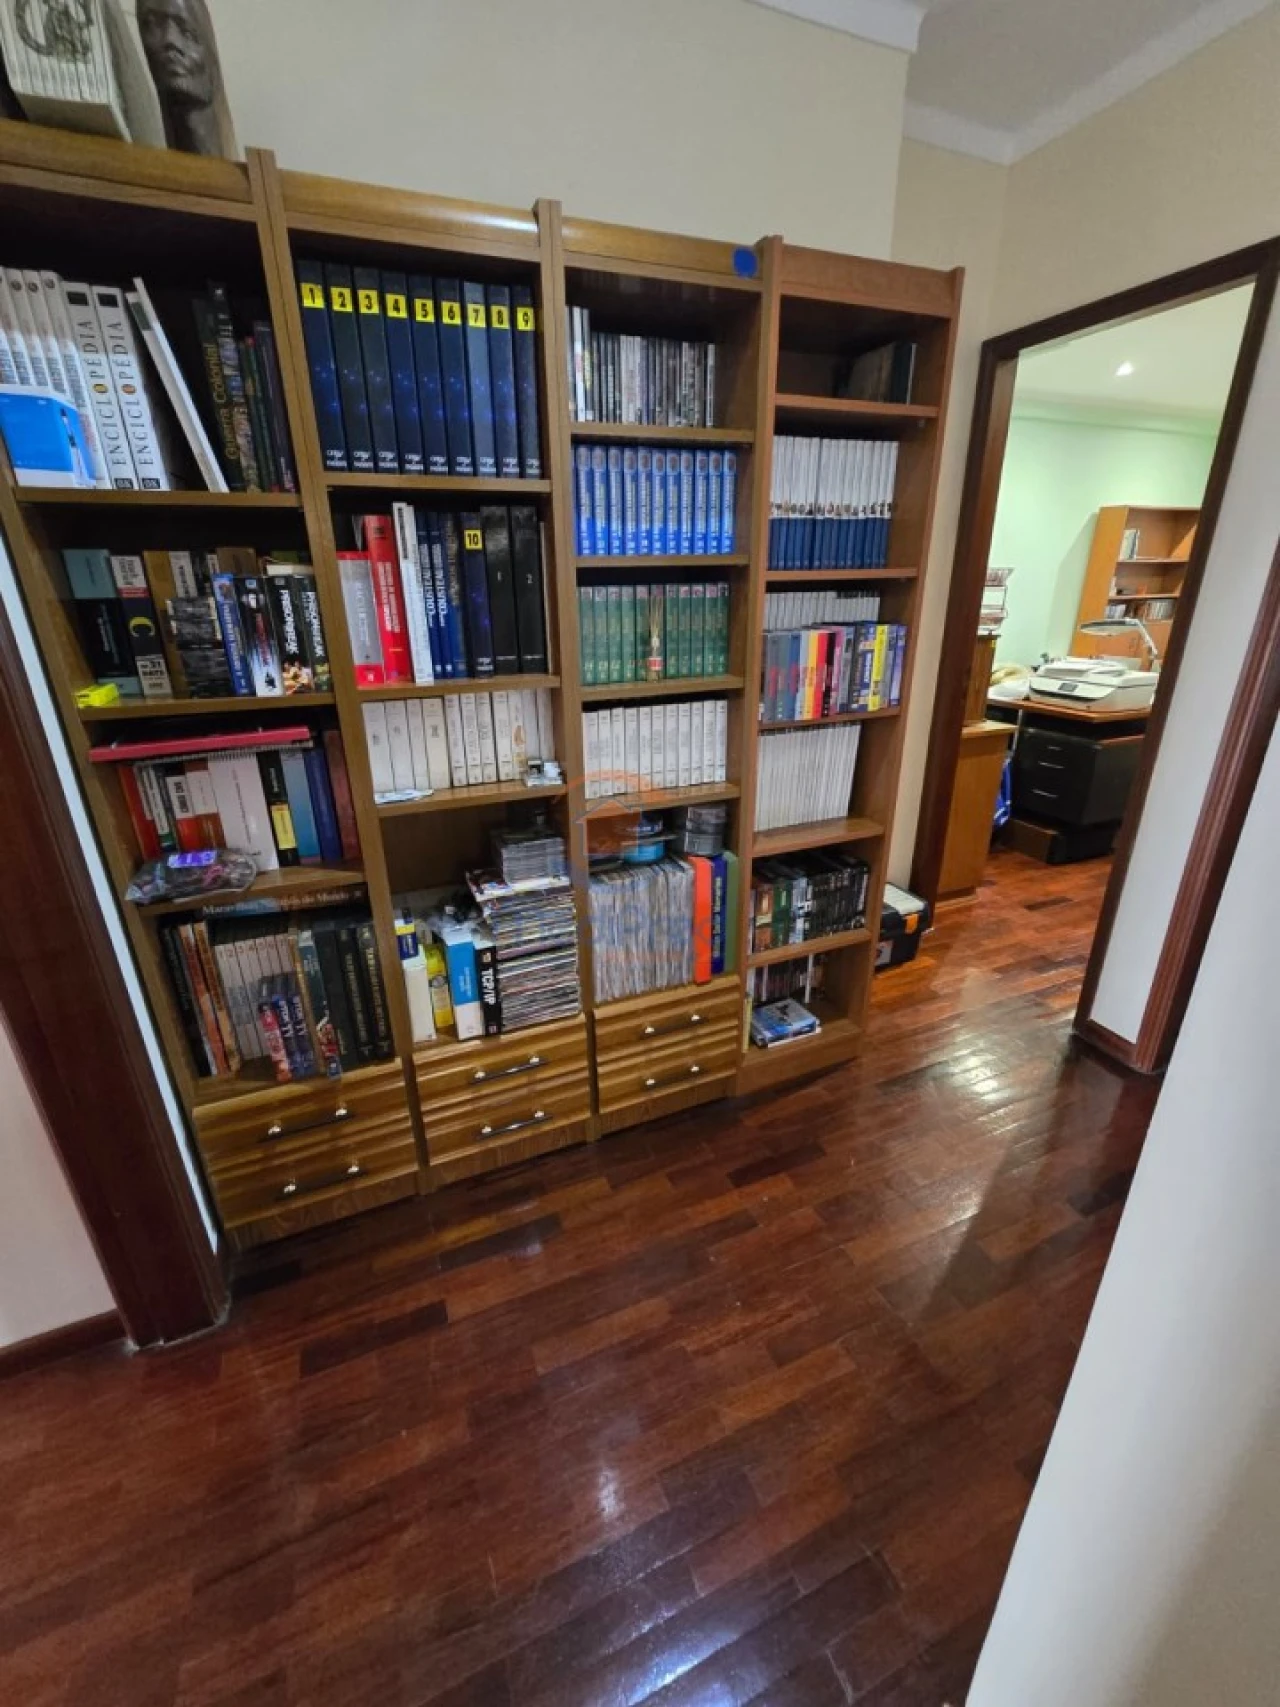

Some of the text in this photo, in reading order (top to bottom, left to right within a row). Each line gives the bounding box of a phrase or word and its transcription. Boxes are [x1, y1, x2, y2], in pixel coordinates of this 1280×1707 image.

[308, 287, 316, 304] 1
[338, 293, 347, 308] 2
[365, 295, 373, 309] 3
[392, 299, 400, 314] 4
[421, 303, 429, 318] 5
[447, 305, 455, 320] 6
[473, 308, 480, 322] 7
[497, 310, 504, 325] 8
[522, 312, 530, 327] 9
[77, 321, 128, 465] ENCICLOPÉDIA
[467, 533, 478, 546] 10
[129, 617, 155, 637] C
[481, 967, 496, 1005] TCP/IP
